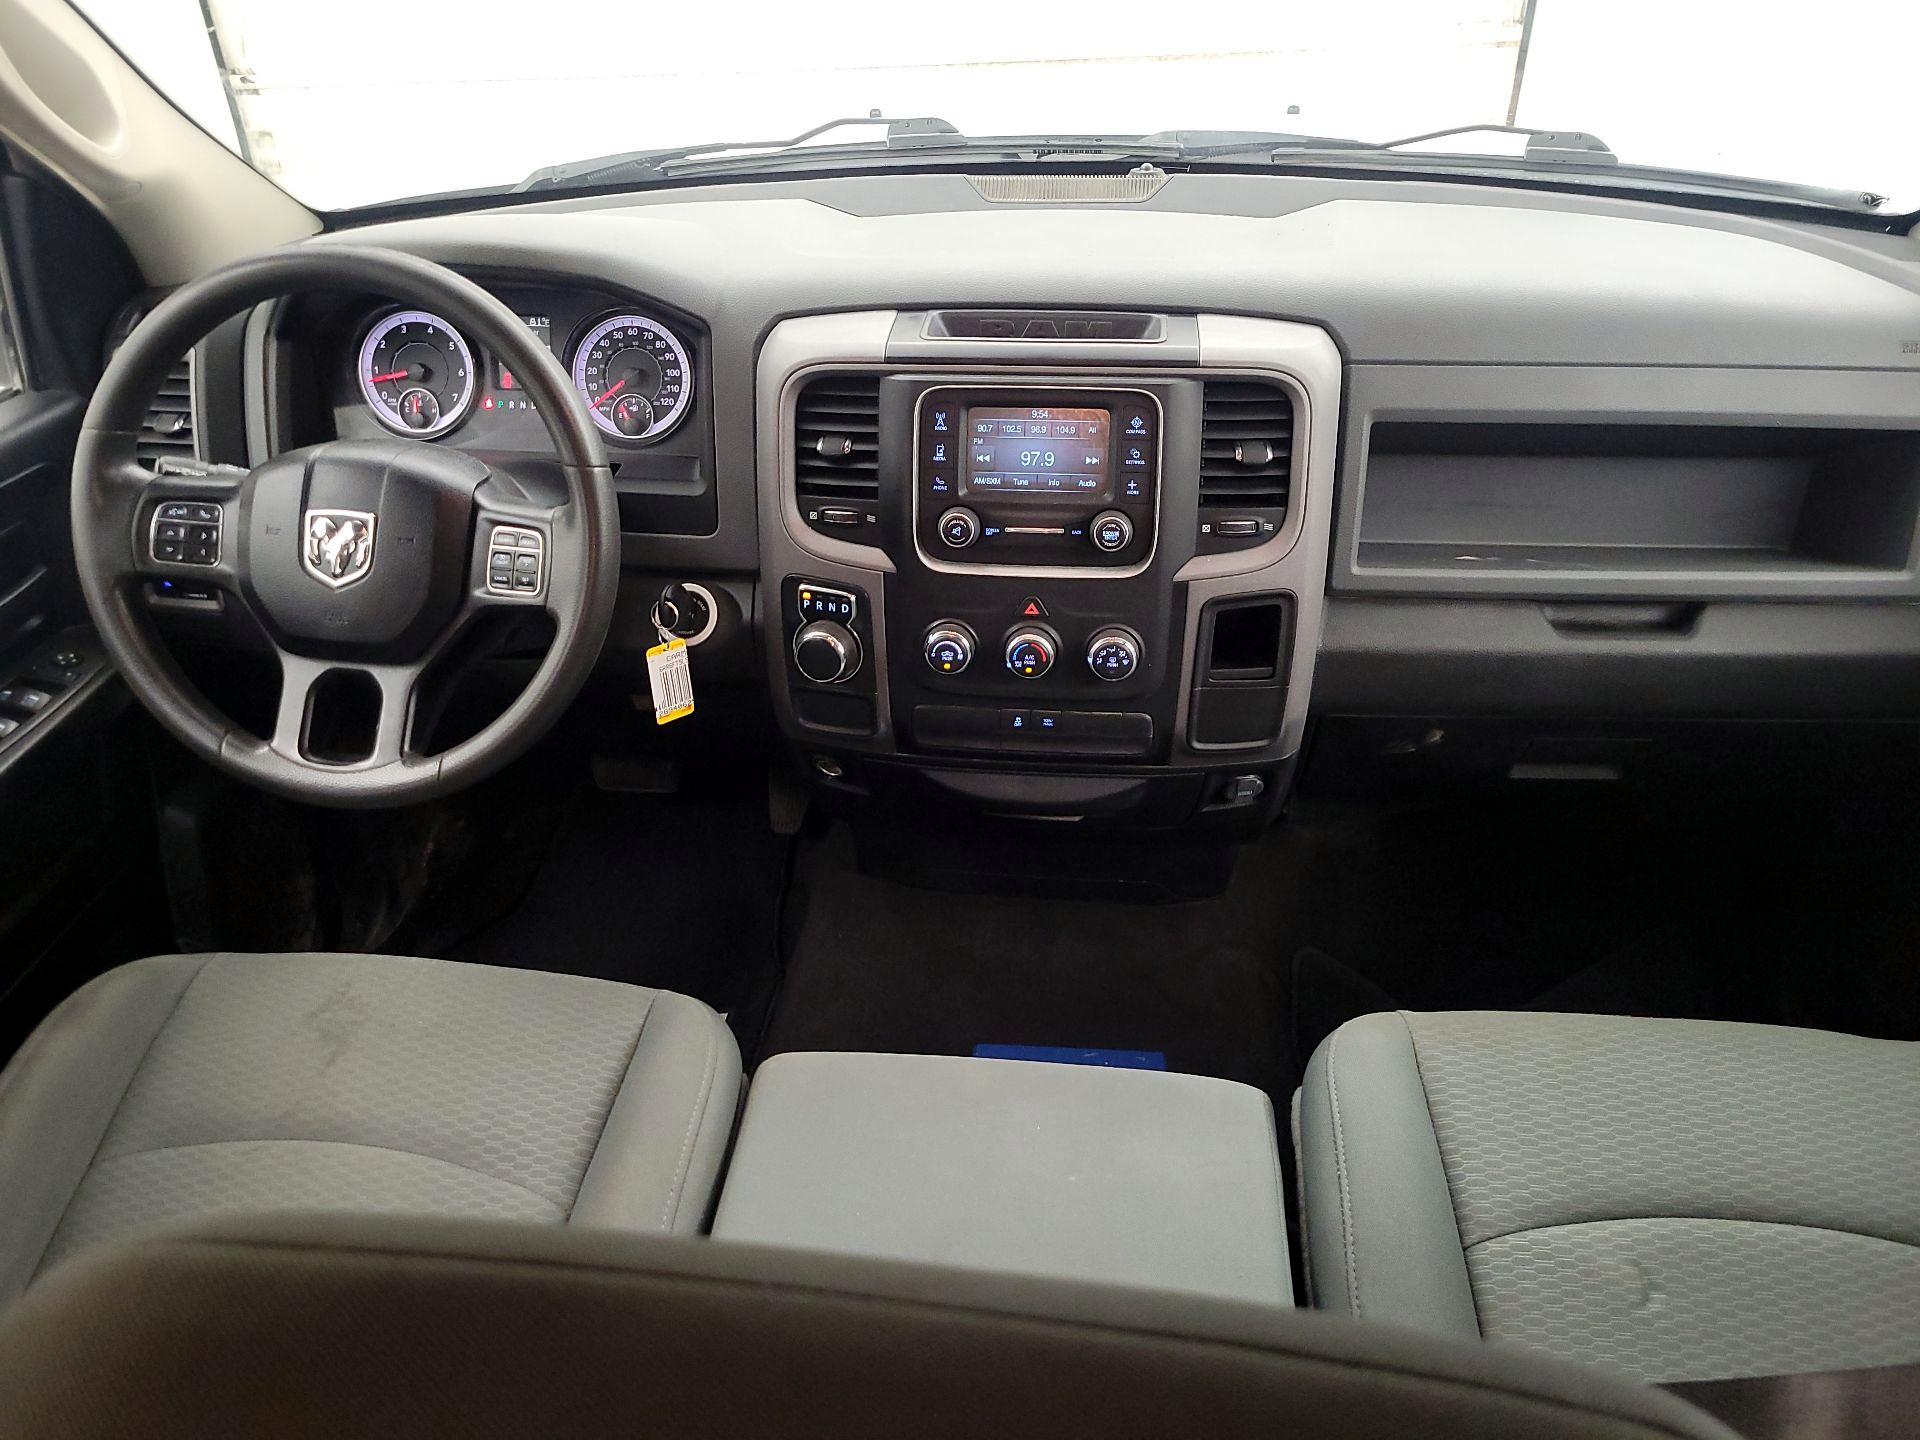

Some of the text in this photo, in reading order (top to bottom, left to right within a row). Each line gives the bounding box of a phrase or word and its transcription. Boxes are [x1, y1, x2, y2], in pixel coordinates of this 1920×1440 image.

[401, 325, 407, 334] 3
[428, 326, 434, 334] 4
[627, 328, 638, 336] 60
[979, 319, 1113, 338] RAM
[613, 331, 624, 339] 50
[643, 332, 654, 340] 70
[380, 340, 386, 349] 2
[449, 341, 455, 350] 5
[599, 339, 610, 347] 40
[655, 341, 666, 349] 80
[592, 351, 602, 359] 30
[664, 353, 675, 361] 90
[374, 365, 379, 374] 1
[458, 368, 465, 377] 6
[587, 367, 598, 375] 20
[666, 369, 680, 377] 100
[588, 383, 598, 391] 10
[666, 385, 680, 393] 110
[382, 391, 388, 400] 0
[452, 393, 459, 402] 7
[660, 398, 675, 406] 120
[977, 424, 993, 433] 90.7
[1002, 425, 1022, 433] 102.5
[1031, 425, 1047, 434] 96.9
[1056, 426, 1076, 434] 104.9
[1021, 451, 1055, 467] 97.9
[1012, 478, 1029, 486] Tune
[1048, 478, 1060, 486] Info
[803, 600, 849, 613] P R N D
